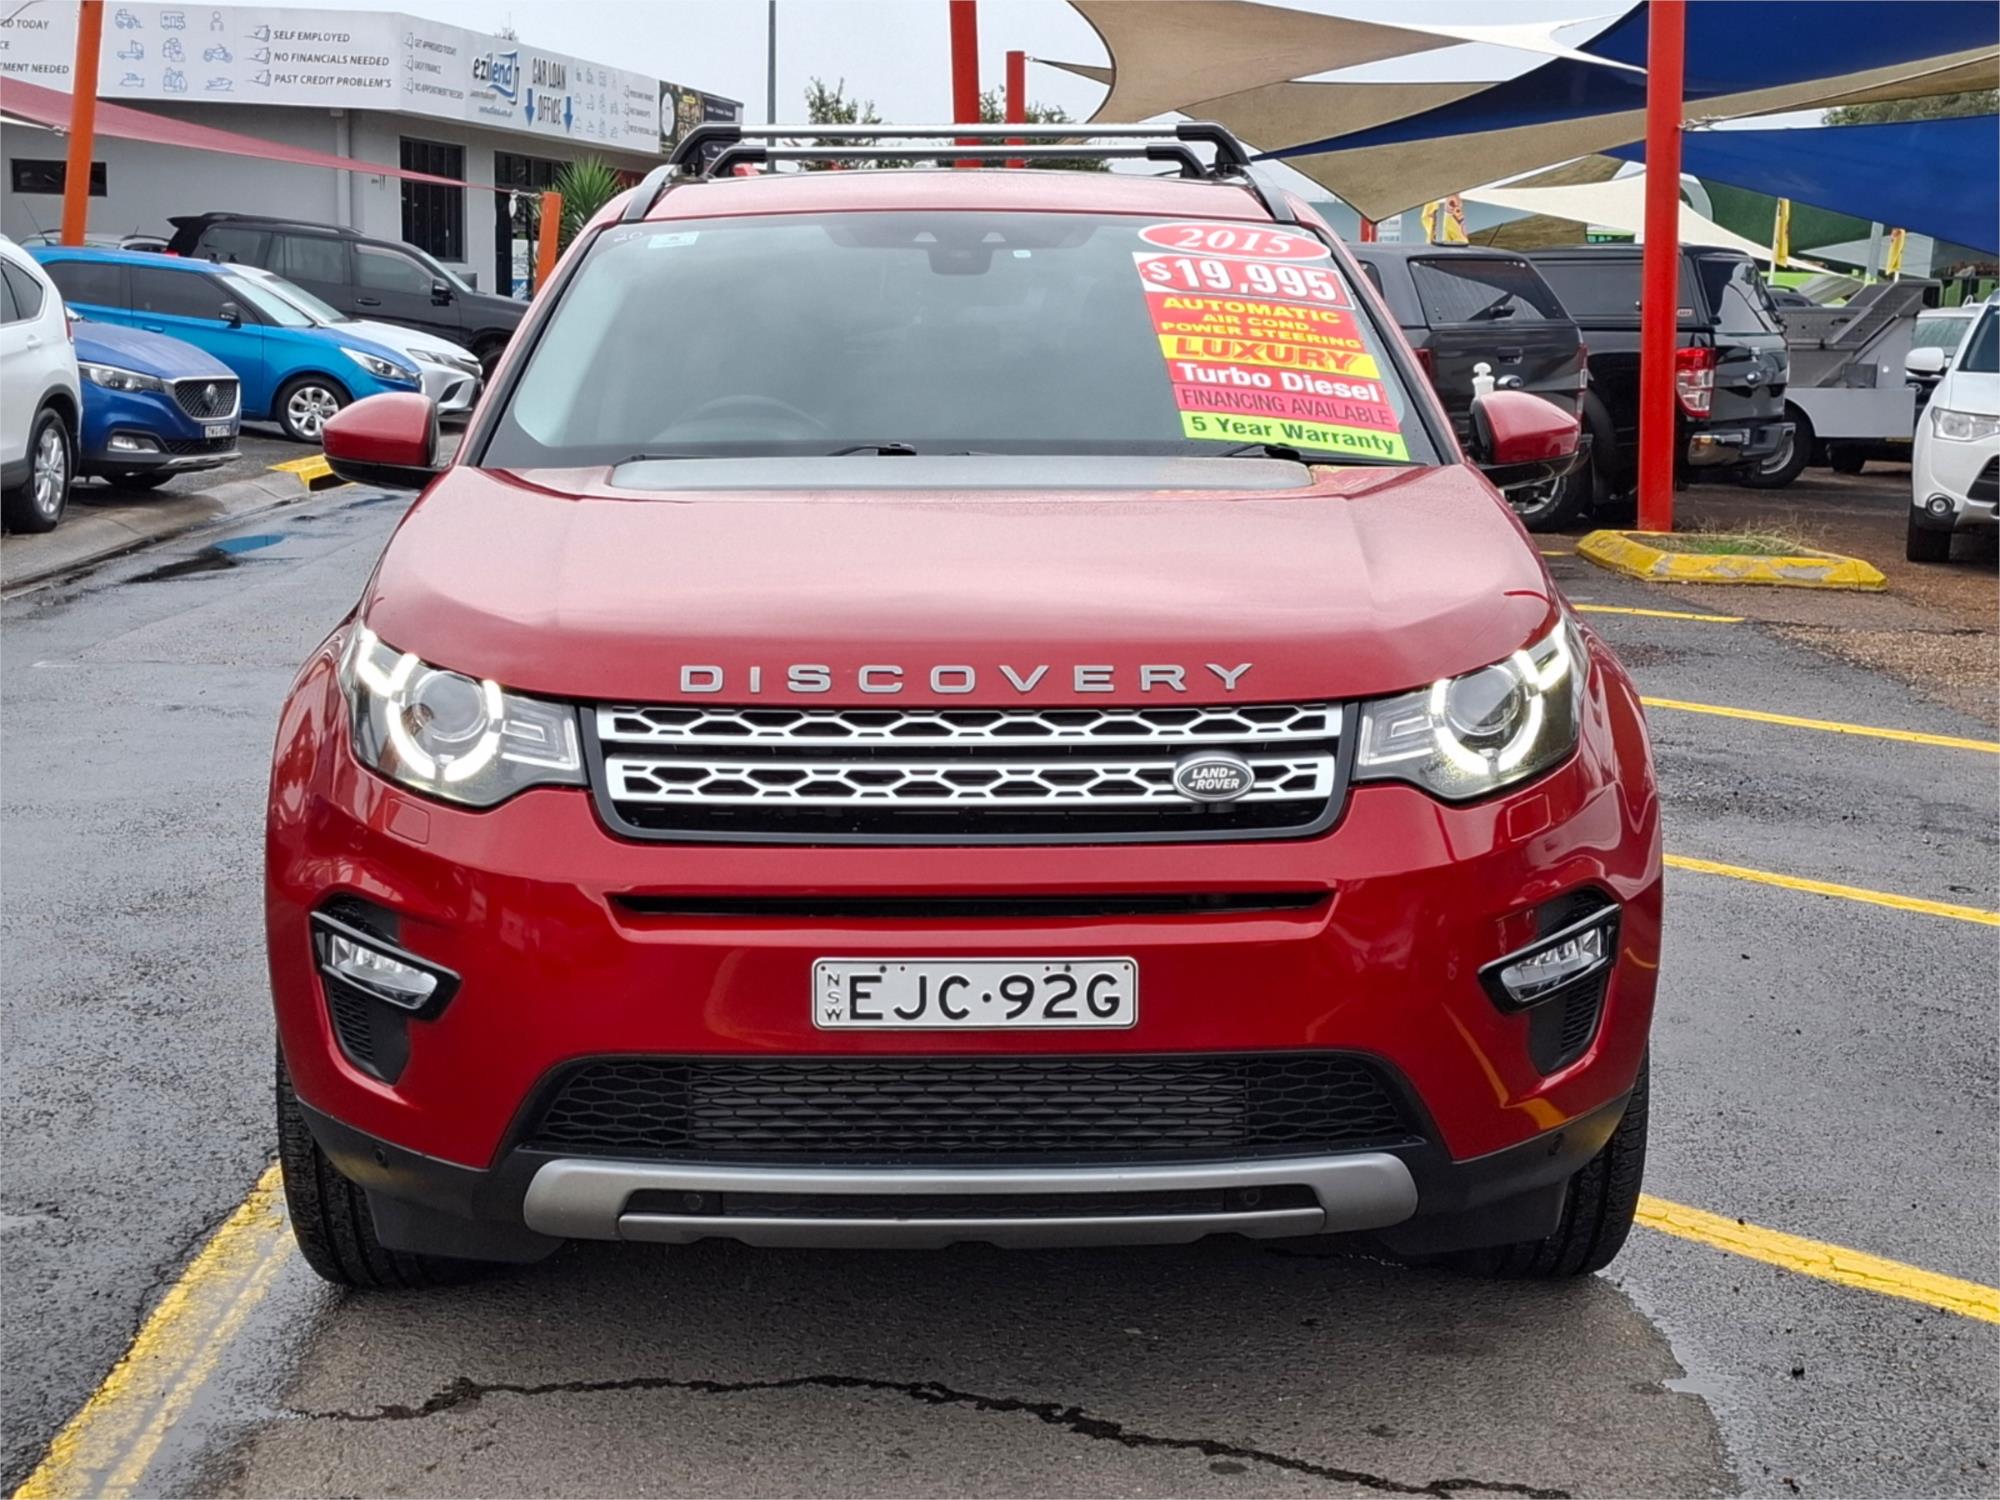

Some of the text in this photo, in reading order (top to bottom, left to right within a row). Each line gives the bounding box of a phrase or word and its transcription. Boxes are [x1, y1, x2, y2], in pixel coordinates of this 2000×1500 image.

[16, 19, 49, 30] TODAY
[273, 30, 350, 42] SELF EMPLOYED
[31, 64, 70, 74] NEEDED
[274, 52, 390, 66] NO FINANCIALS NEEDED
[274, 73, 393, 88] PAST CREDIT PROBLEM'S
[532, 57, 567, 90] CAR LOAN
[538, 94, 562, 125] OFFICE
[1174, 228, 1294, 254] 2015
[1147, 258, 1337, 301] $19,995
[1163, 297, 1341, 324] AUTOMATIC
[1202, 314, 1317, 332] AIR COND.
[1161, 322, 1362, 349] POWER STEERING
[1176, 337, 1360, 372] LUXURY
[1176, 361, 1380, 401] Turbo Diesel
[1181, 388, 1394, 427] FINANCING AVAILABLE
[1191, 416, 1395, 455] 5 Year Warranty
[680, 663, 1254, 694] DISCOVERY
[1192, 767, 1228, 779] LAND
[1196, 778, 1239, 790] ROVER
